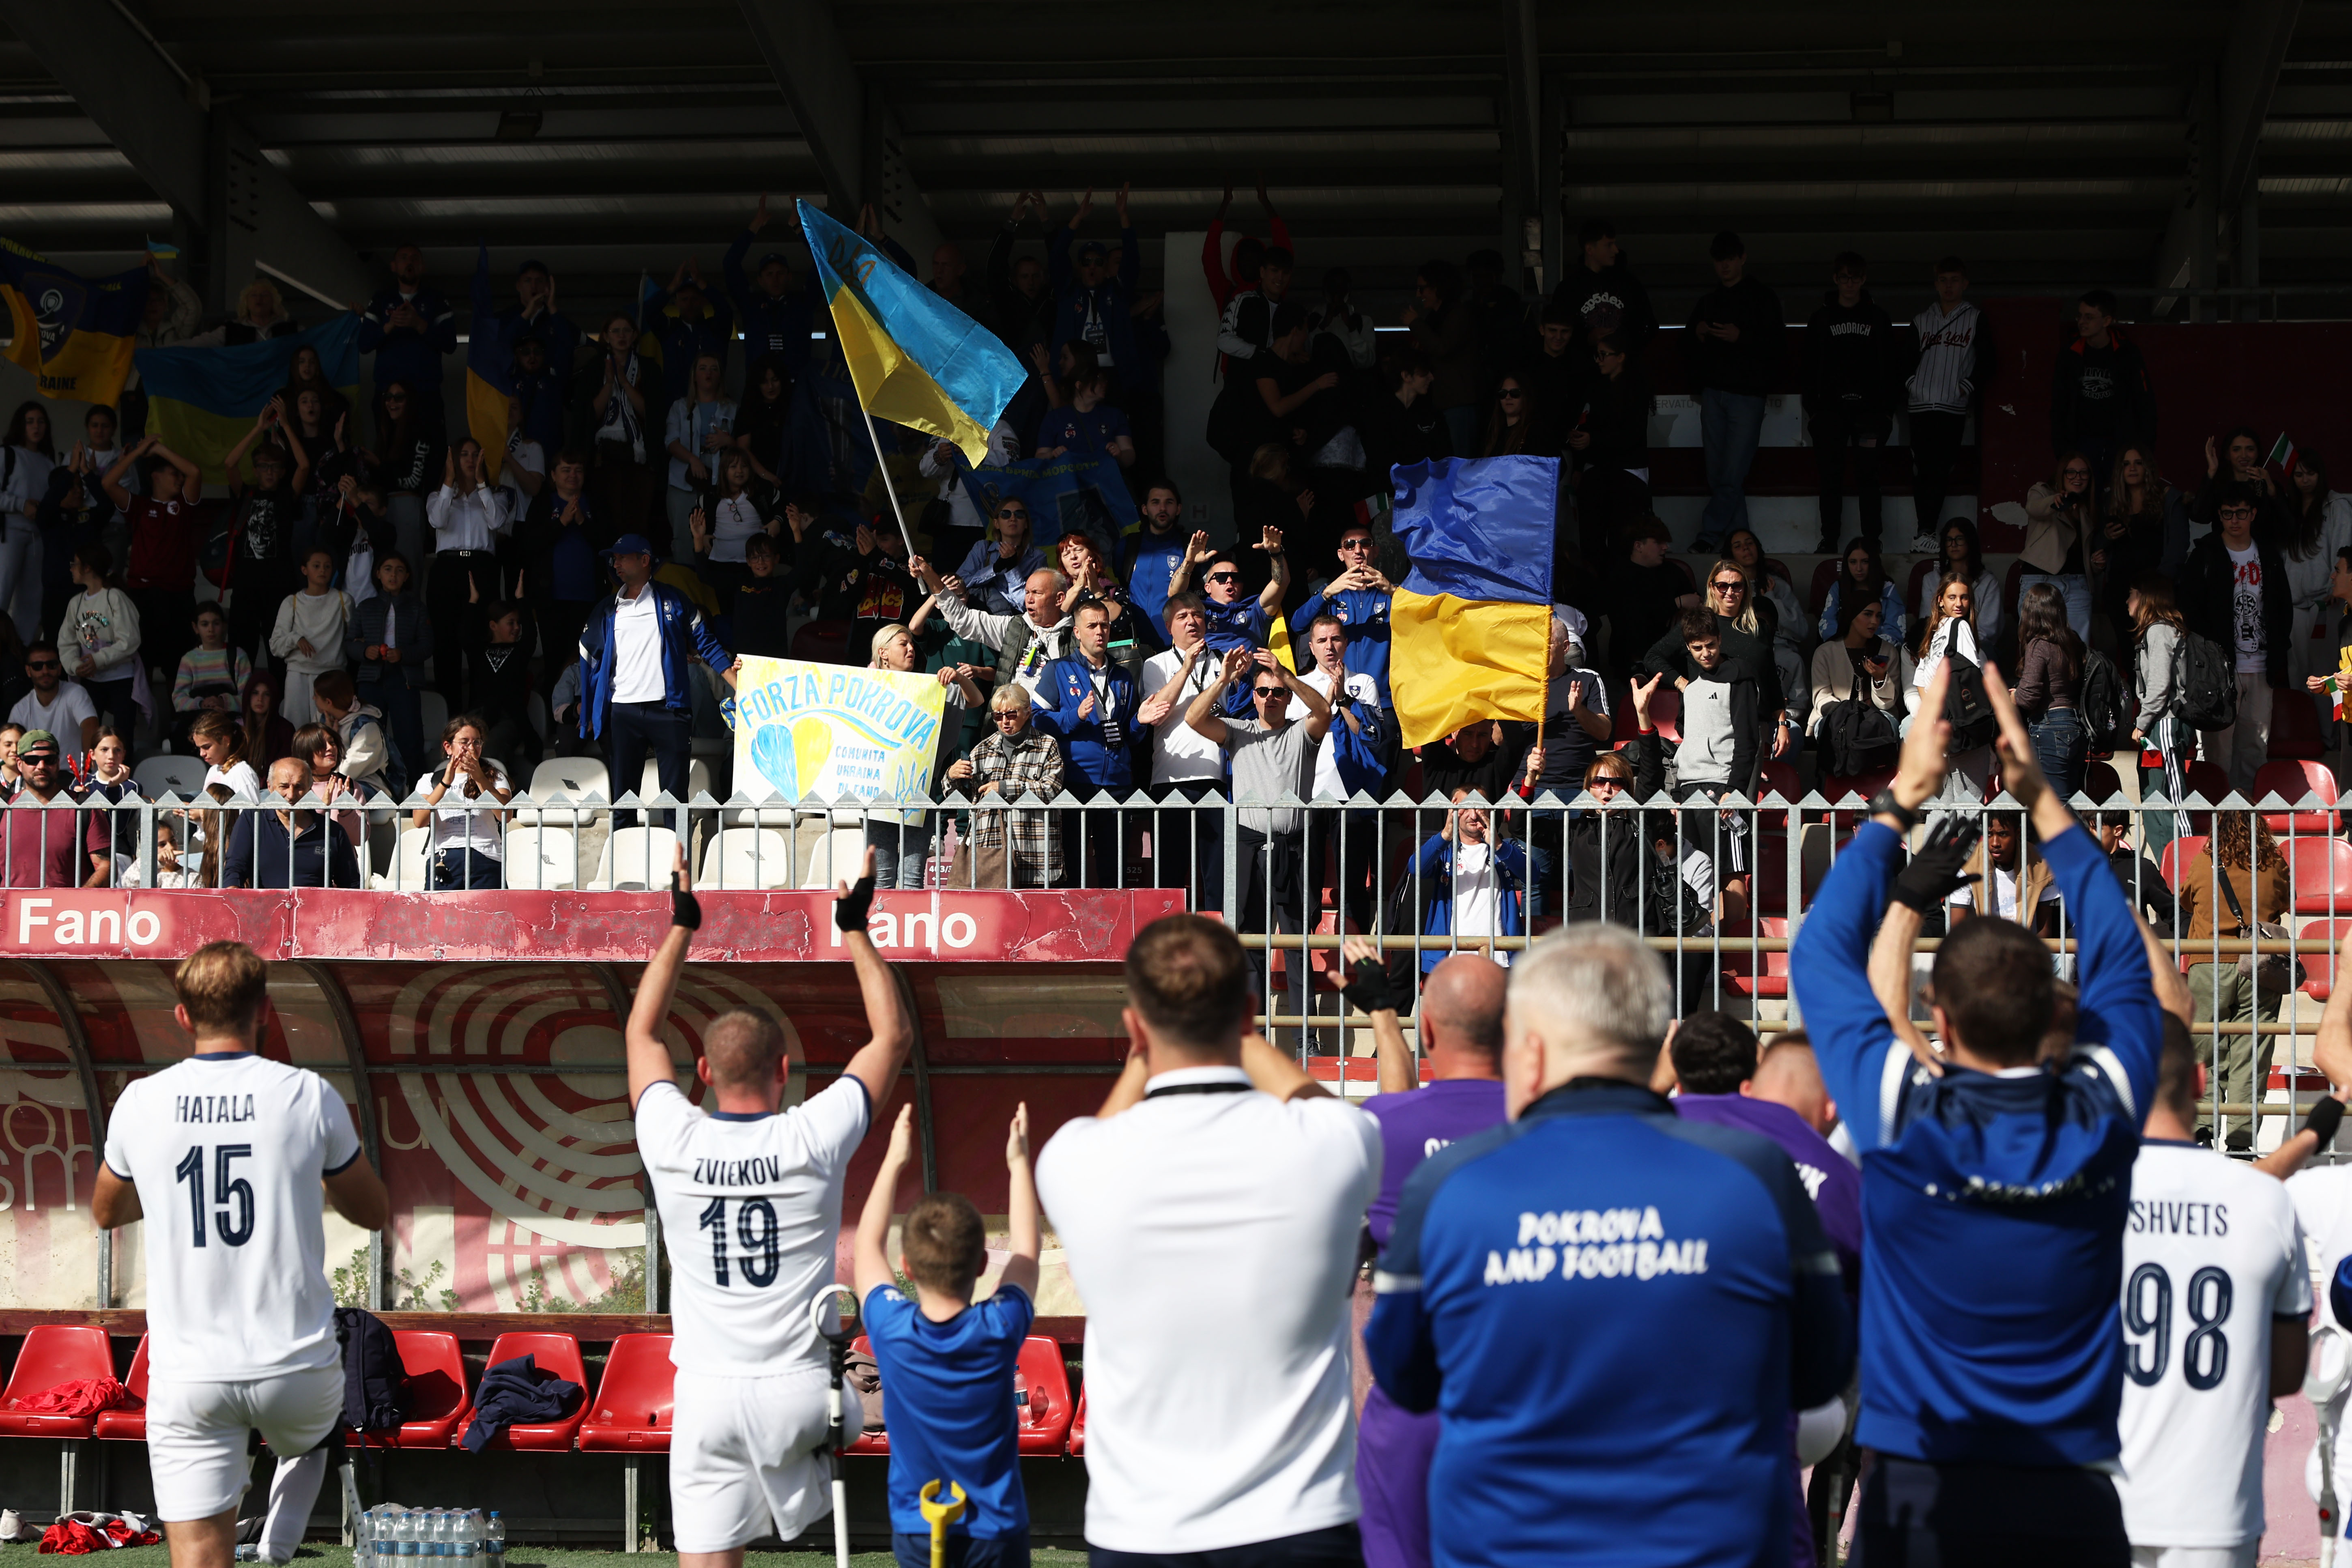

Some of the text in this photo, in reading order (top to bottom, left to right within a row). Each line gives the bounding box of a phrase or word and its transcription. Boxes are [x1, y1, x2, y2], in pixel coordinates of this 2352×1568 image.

[1581, 292, 1624, 314] sp5der
[1830, 322, 1871, 336] HOODRICH
[1944, 328, 1971, 348] York
[40, 375, 76, 390] RAINE
[1655, 400, 1694, 409] ERVATO
[739, 673, 937, 750] FORZA POKROVA
[835, 745, 885, 763] COMUNITA
[837, 782, 879, 799] DI FANO
[19, 898, 161, 945] Fano
[176, 1094, 255, 1123] HATALA
[694, 1155, 780, 1186] ZVIEKOV
[176, 1144, 254, 1248] 15
[1517, 1204, 1665, 1247] POKROVA
[2131, 1201, 2227, 1236] SHVETS
[700, 1196, 780, 1288] 19
[1483, 1238, 1709, 1287] AMP FOOTBALL
[2125, 1263, 2232, 1390] 98
